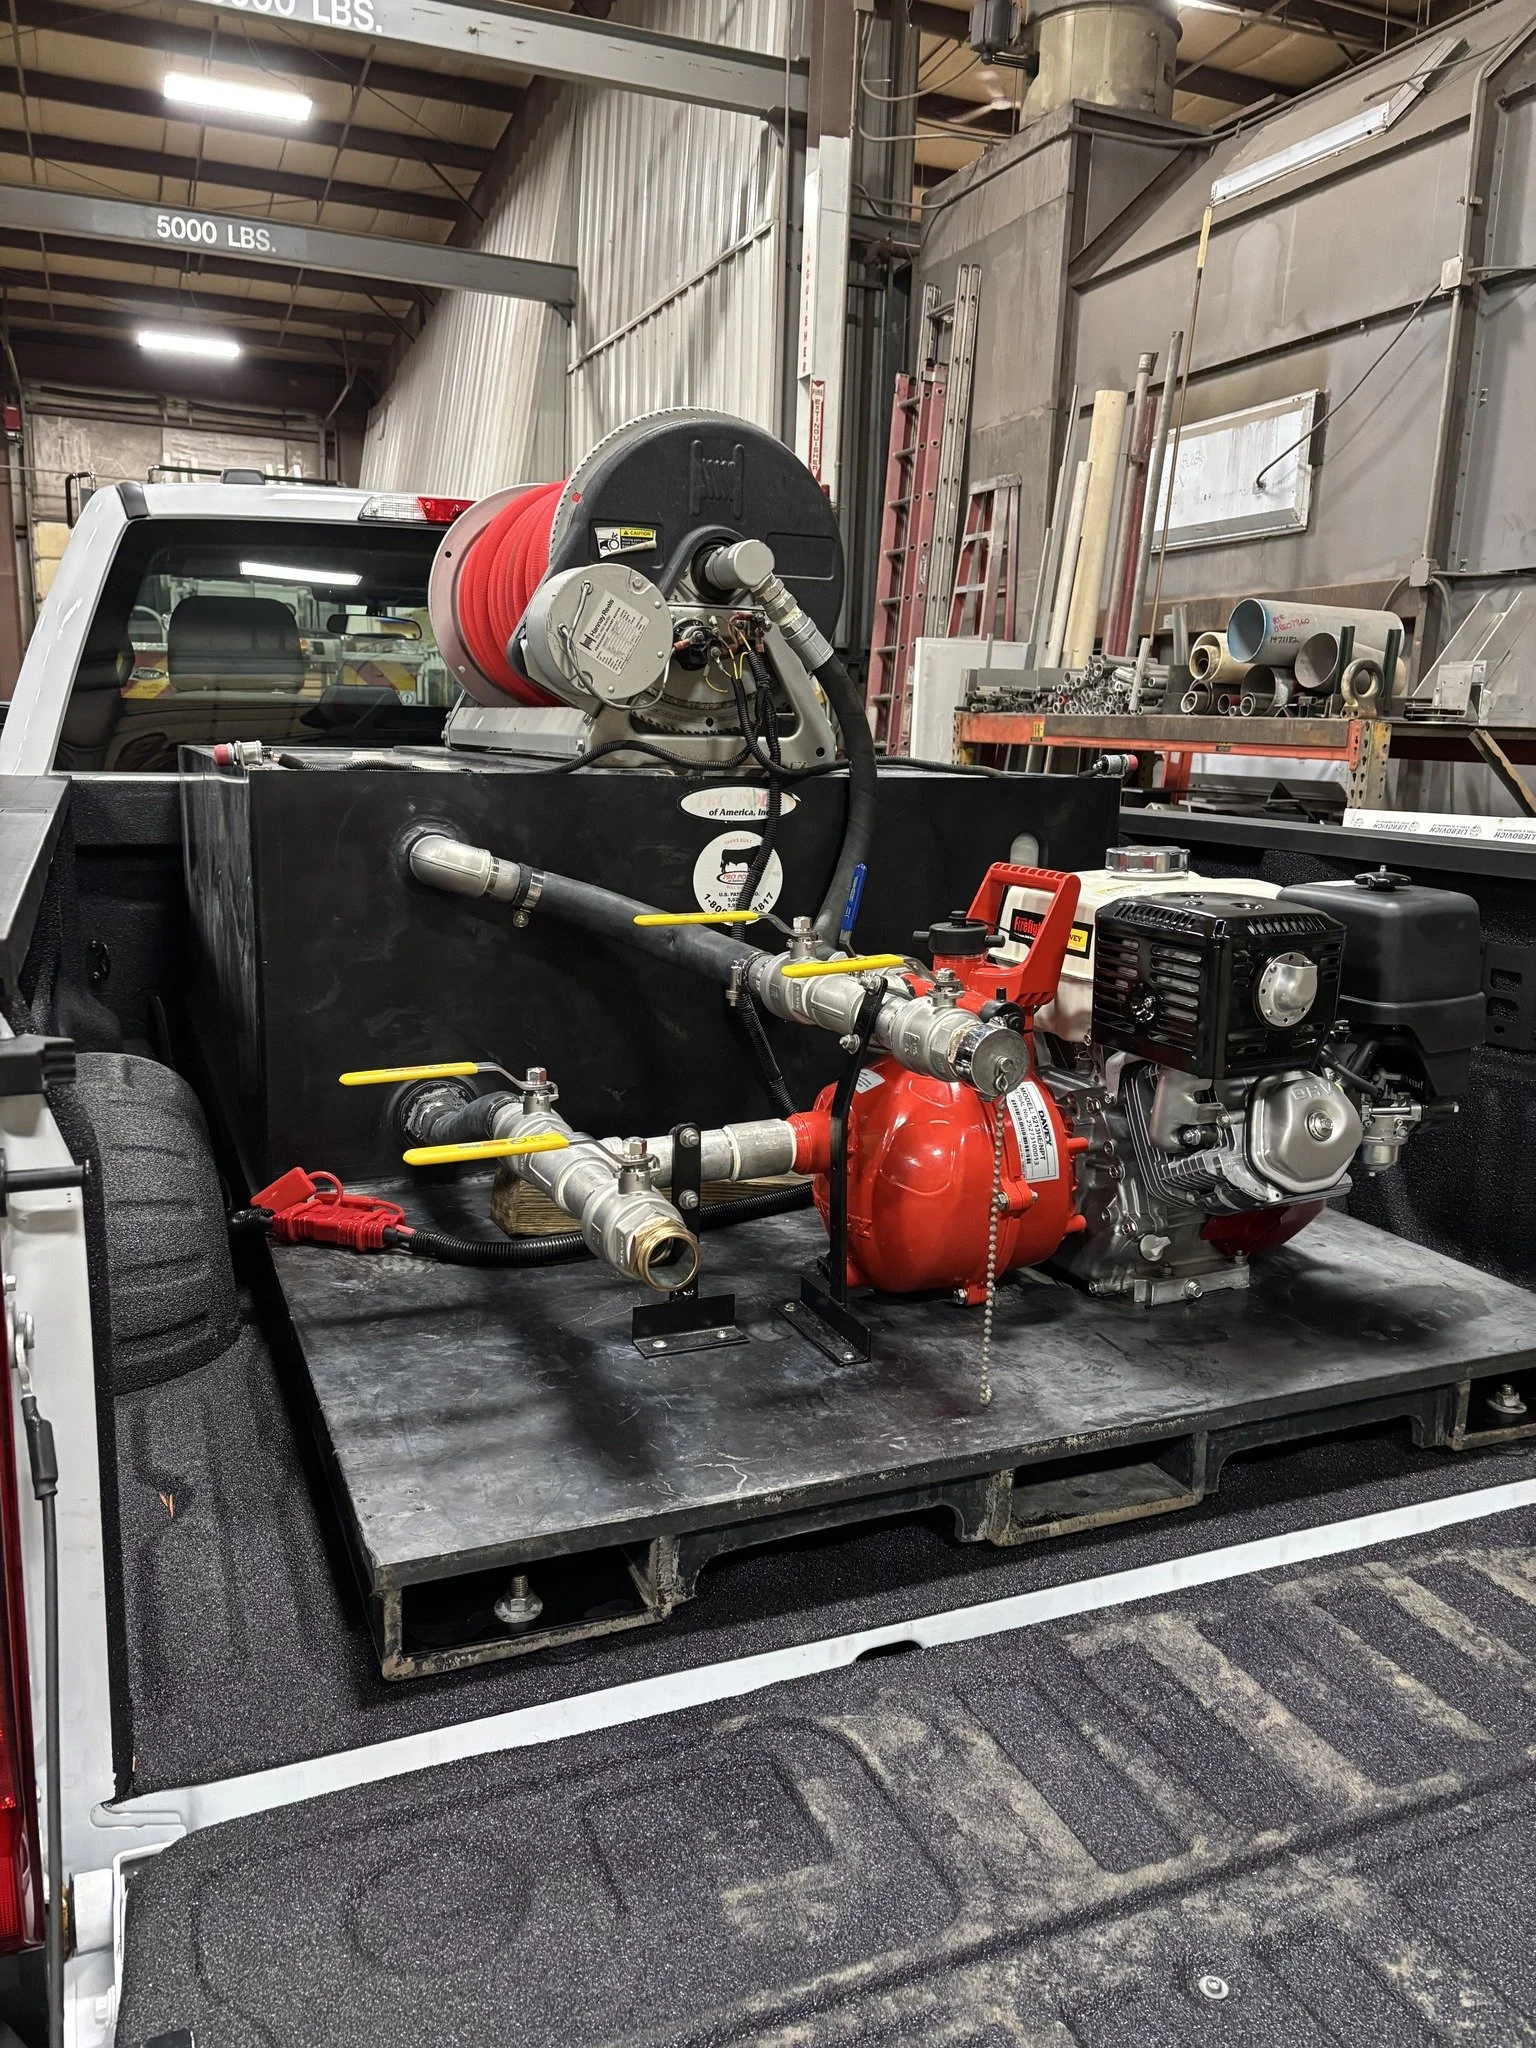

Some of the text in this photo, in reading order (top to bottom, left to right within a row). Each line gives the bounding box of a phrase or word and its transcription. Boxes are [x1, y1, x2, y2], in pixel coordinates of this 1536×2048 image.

[312, 0, 383, 34] LBS.
[156, 215, 277, 253] 5000 LBS.
[812, 399, 822, 471] EXTINGUISHER
[589, 598, 614, 637] Hannay Reels
[719, 809, 756, 817] America,
[1429, 826, 1469, 836] LIEBOVICH
[1020, 1087, 1036, 1115] MODEL:
[1038, 1110, 1052, 1147] DAVEY
